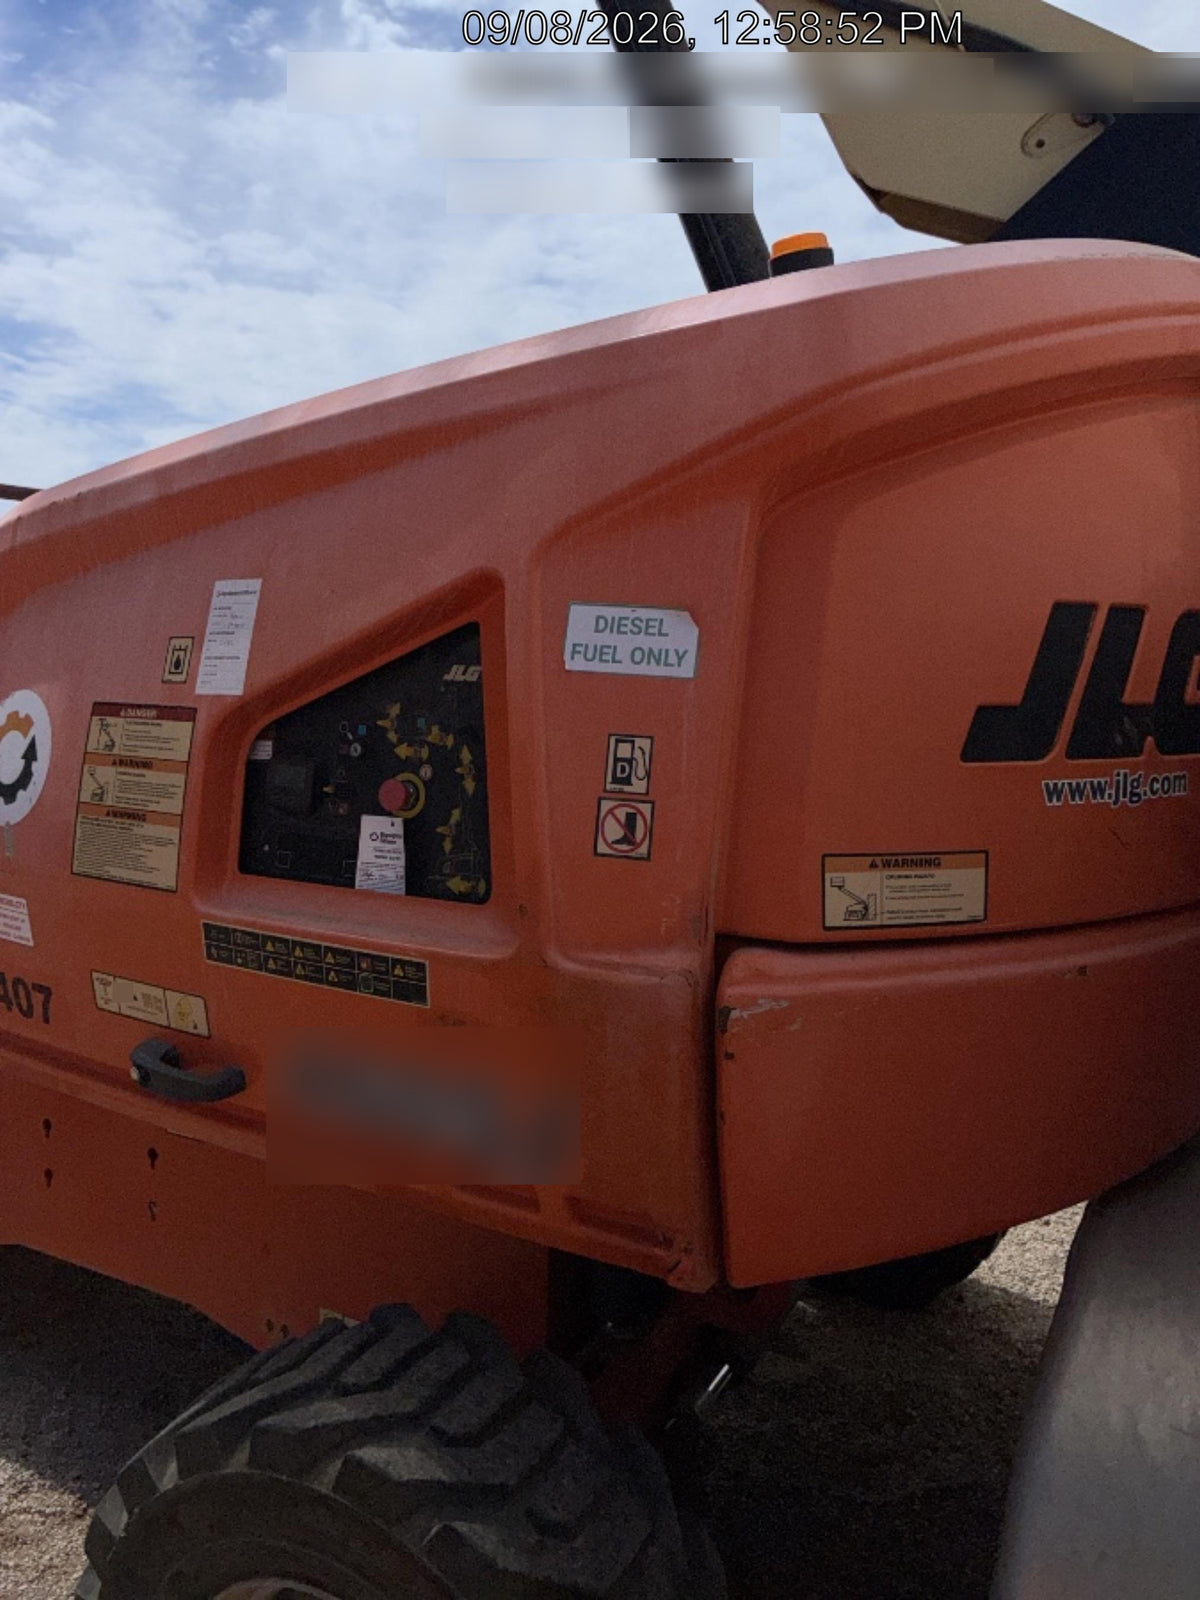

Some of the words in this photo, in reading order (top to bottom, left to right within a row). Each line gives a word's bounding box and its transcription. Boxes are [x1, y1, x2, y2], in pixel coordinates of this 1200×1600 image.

[593, 614, 670, 638] DIESEL
[569, 642, 624, 664] FUEL
[629, 646, 689, 669] ONLY
[442, 664, 482, 681] JLG
[616, 761, 630, 778] D
[1042, 771, 1188, 805] www.jlg.com
[881, 857, 942, 869] WARNING
